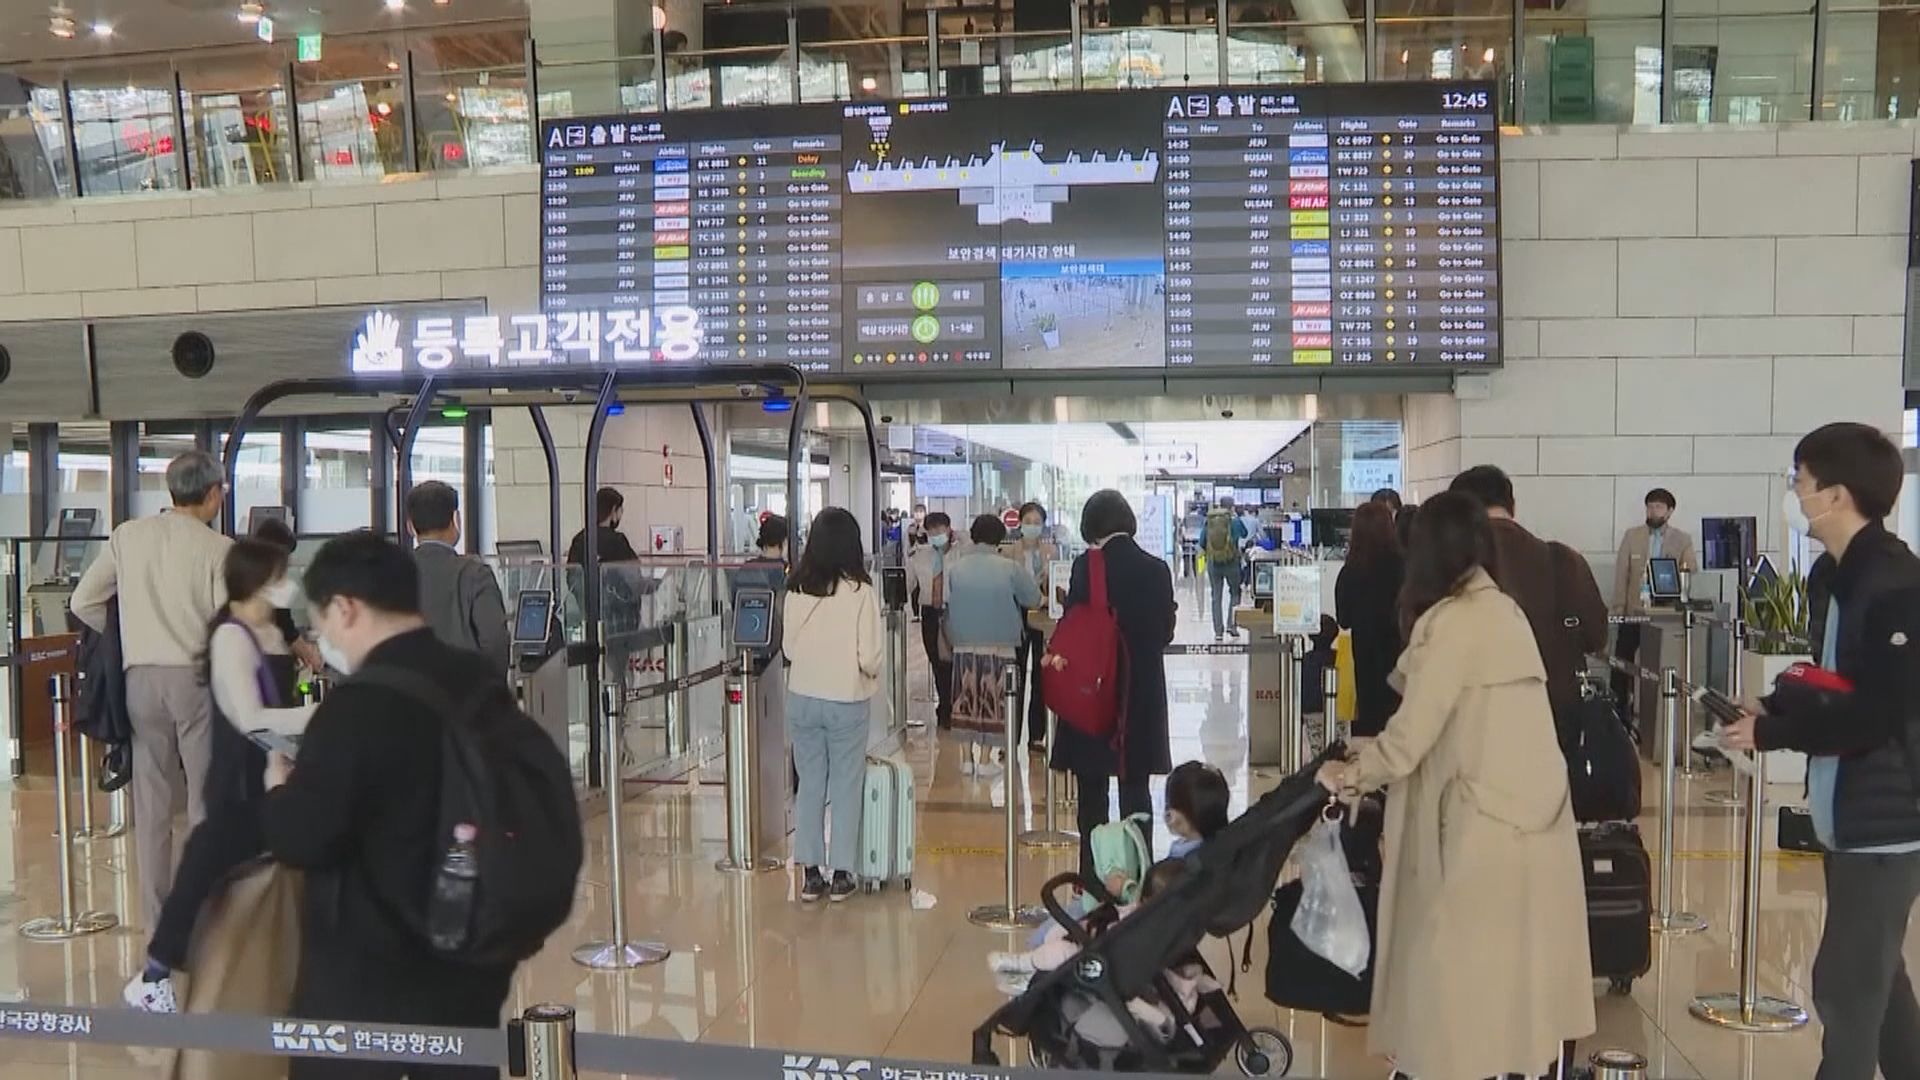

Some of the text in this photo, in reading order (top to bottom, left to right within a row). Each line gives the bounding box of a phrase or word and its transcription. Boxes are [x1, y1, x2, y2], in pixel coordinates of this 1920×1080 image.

[1442, 93, 1487, 108] 12:45
[1168, 96, 1184, 117] A
[549, 128, 564, 148] A
[1461, 135, 1481, 143] Gate
[1437, 151, 1449, 159] Go
[1437, 166, 1449, 174] Go
[1451, 166, 1460, 174] to
[1462, 166, 1481, 174] Gate
[1438, 182, 1450, 190] Go
[1452, 182, 1460, 190] to
[1438, 197, 1450, 205] Go
[1452, 197, 1460, 205] to
[1463, 197, 1482, 205] Gate
[1438, 212, 1450, 220] Go
[1453, 212, 1461, 220] to
[1463, 212, 1482, 220] Gate
[1438, 228, 1450, 236] Go
[1453, 228, 1461, 236] to
[1463, 228, 1482, 236] Gate
[1052, 244, 1075, 258] 안내
[1439, 243, 1451, 251] Go
[1453, 243, 1462, 251] to
[1464, 243, 1483, 251] Gate
[1439, 258, 1450, 266] Go
[1453, 258, 1462, 266] to
[1464, 258, 1483, 266] Gate
[1440, 275, 1451, 283] Go
[1454, 275, 1463, 283] to
[1440, 290, 1451, 298] Go
[1454, 290, 1463, 298] to
[1465, 290, 1484, 298] Gate
[1440, 305, 1485, 314] Go to Gate
[1465, 321, 1484, 329] Gate
[412, 306, 704, 369] 등록고객전용
[1441, 337, 1452, 345] Go
[1455, 337, 1464, 345] to
[1440, 352, 1452, 360] Go
[1455, 352, 1464, 360] to
[1466, 352, 1485, 360] Gate
[272, 1022, 464, 1055] KAC 한국공항공사
